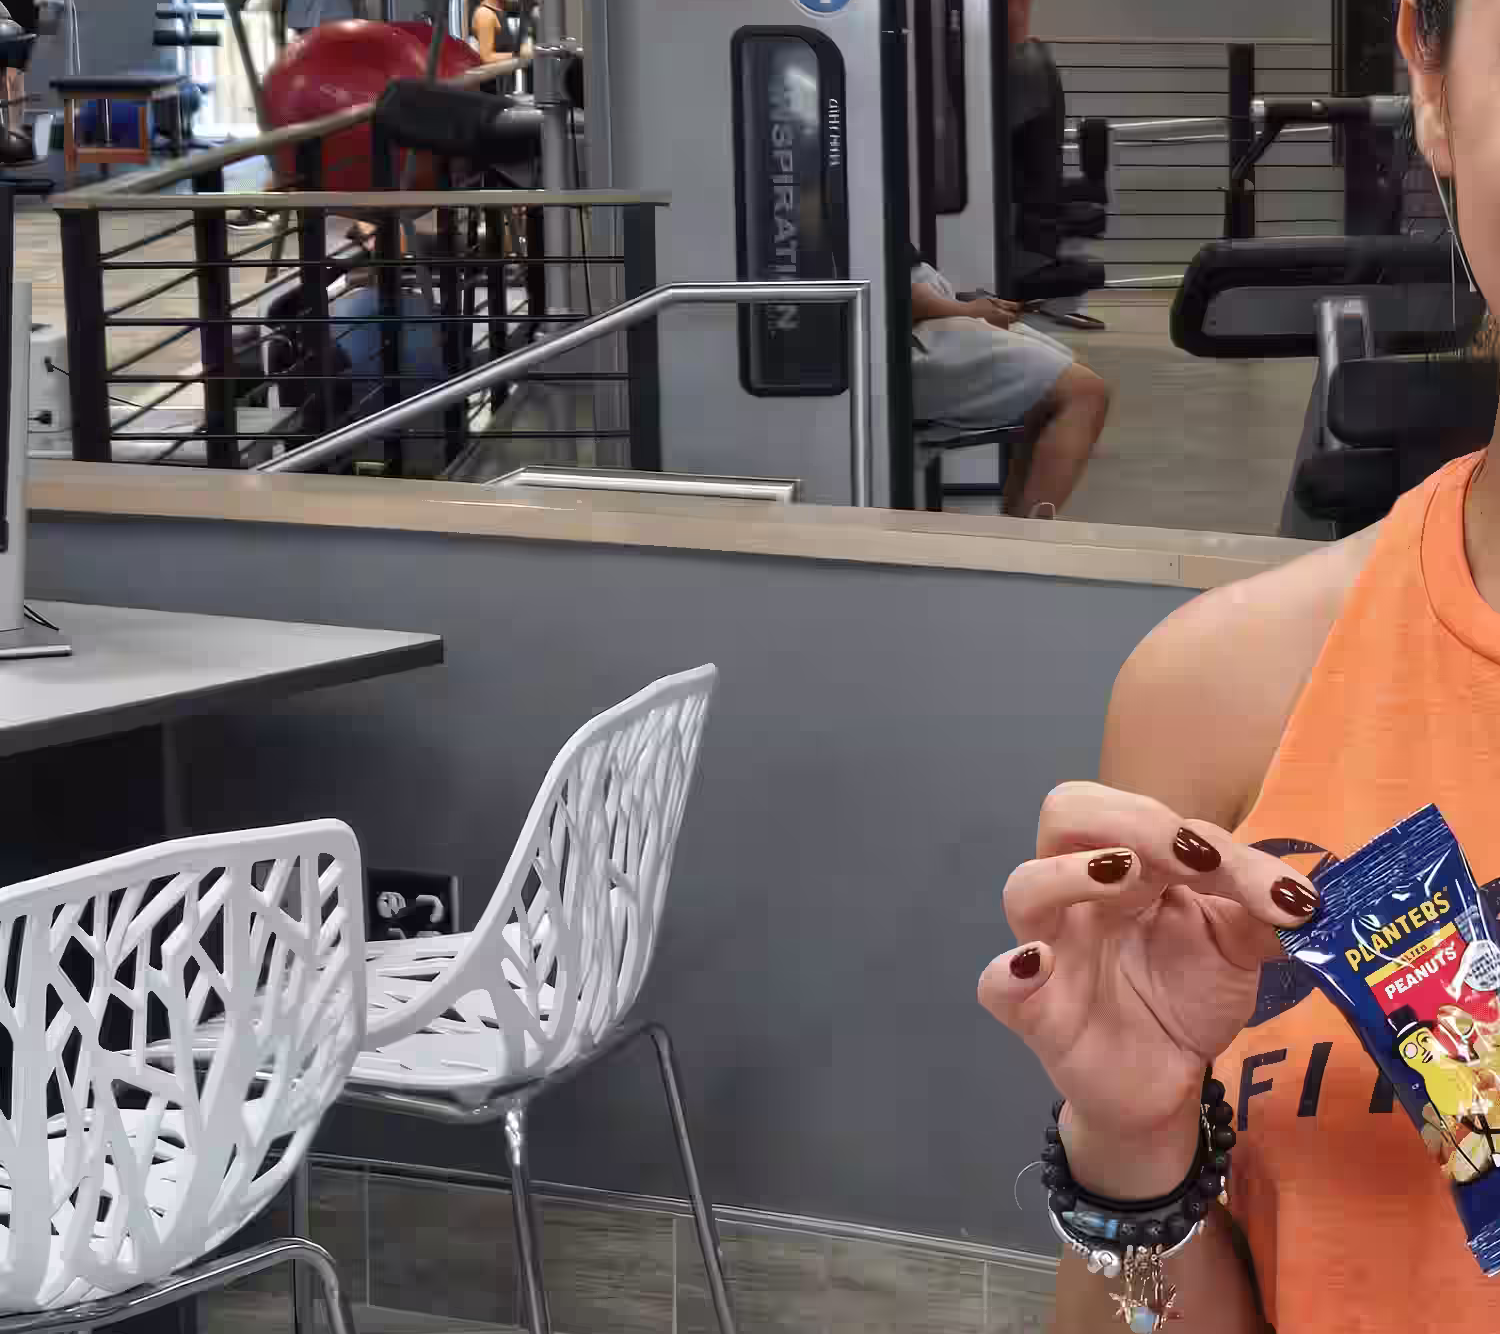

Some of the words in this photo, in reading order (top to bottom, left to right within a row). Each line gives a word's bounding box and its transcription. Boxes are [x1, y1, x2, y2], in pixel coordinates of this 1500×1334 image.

[769, 91, 800, 331] NSPIRATIN
[1345, 892, 1450, 972] PLANTERS
[1384, 943, 1457, 1000] PEANUTS
